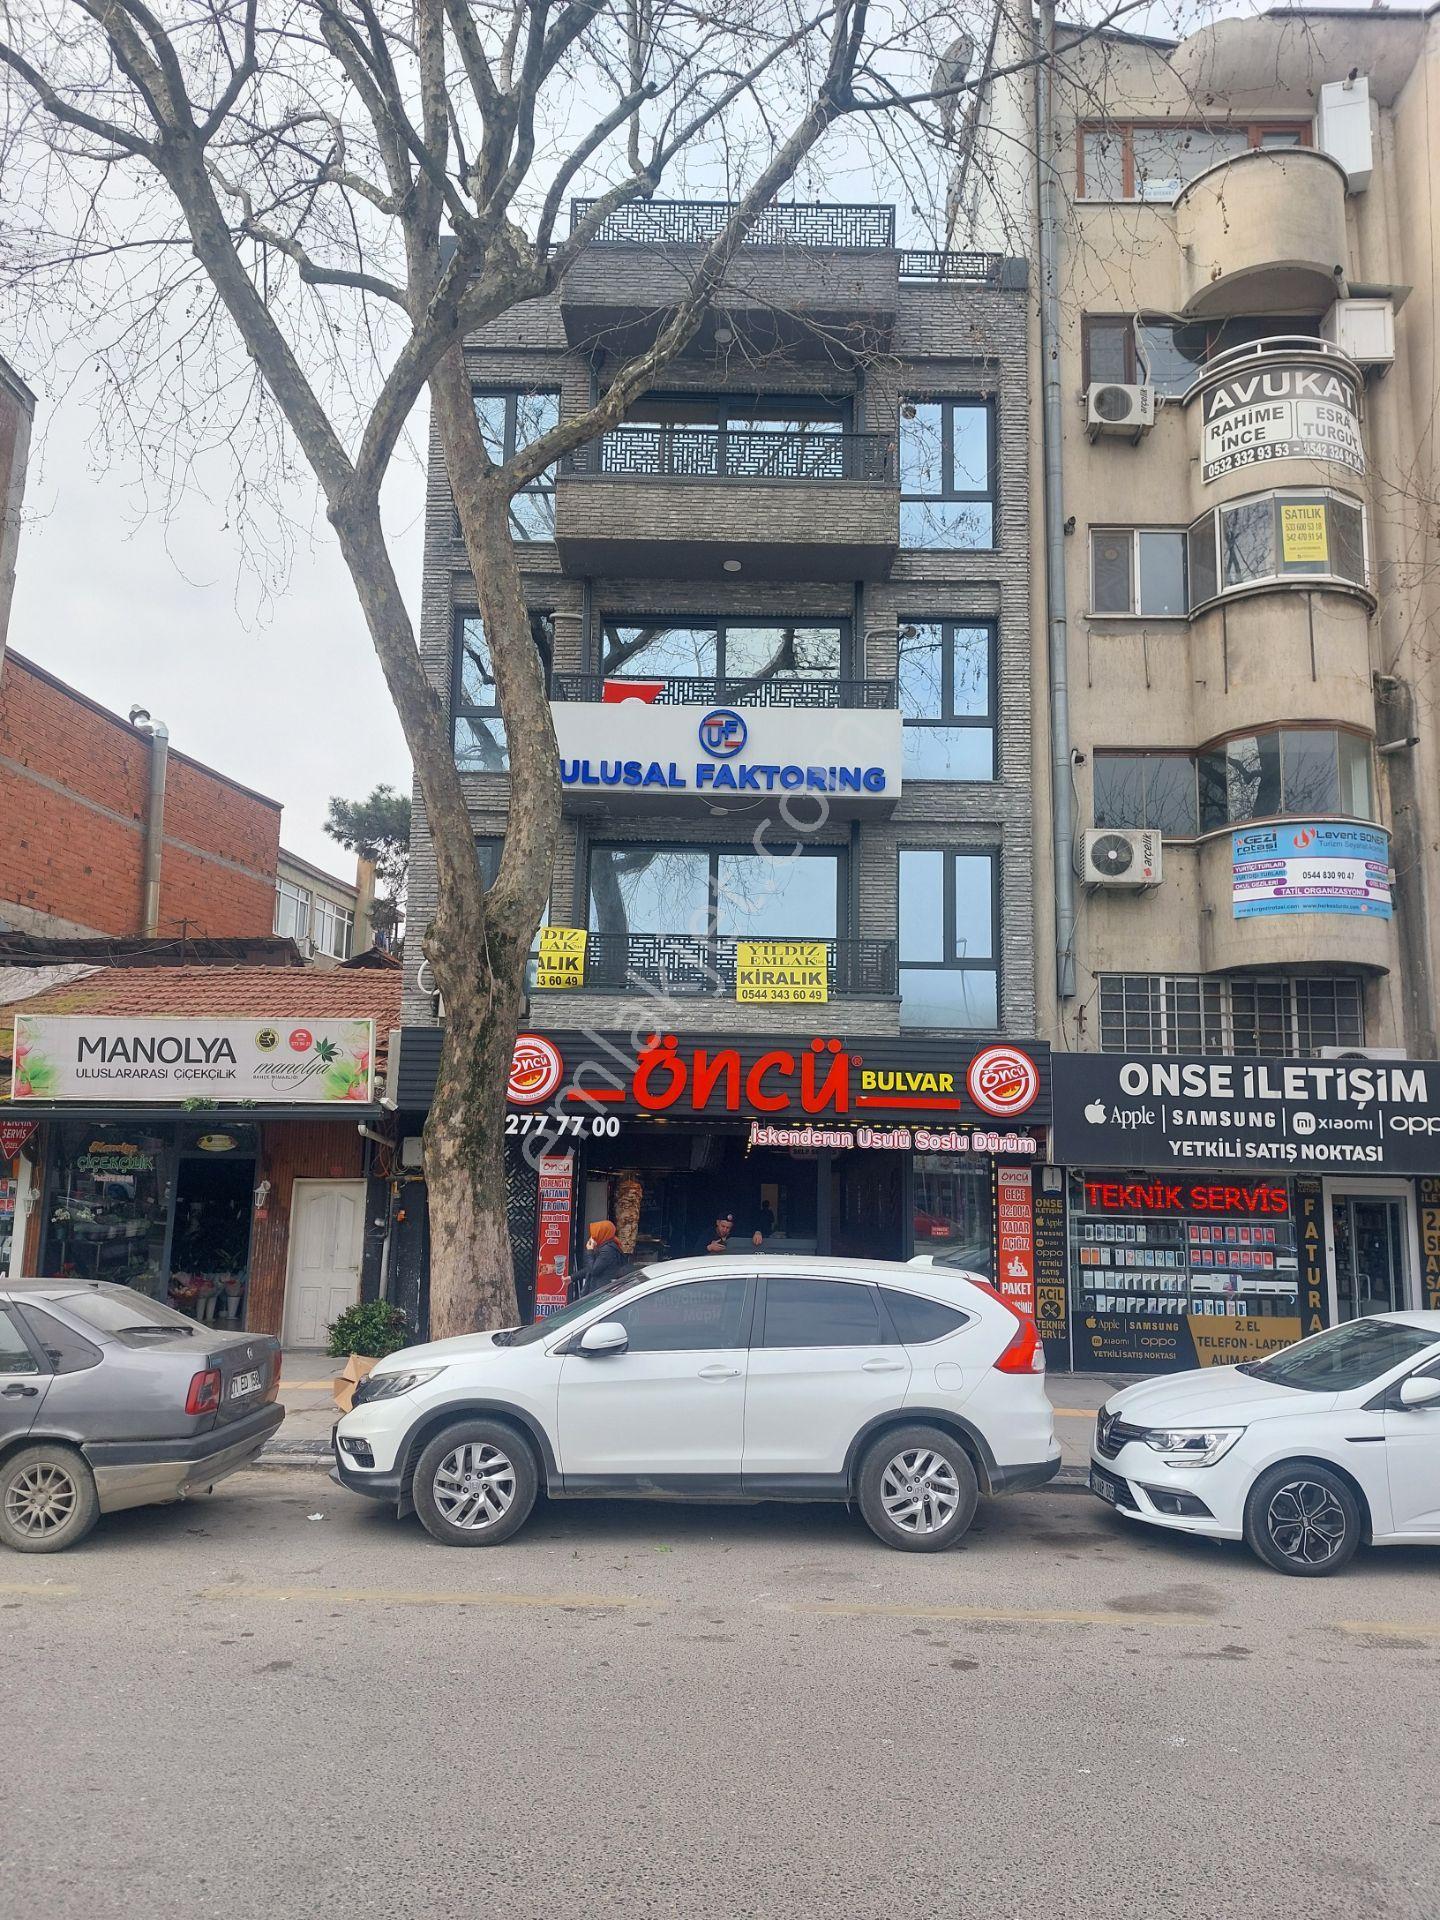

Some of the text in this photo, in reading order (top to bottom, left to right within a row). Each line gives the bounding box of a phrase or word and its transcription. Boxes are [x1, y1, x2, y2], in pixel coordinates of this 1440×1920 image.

[1208, 372, 1354, 418] AVUKAT
[1211, 407, 1284, 440] RAHİME
[1316, 407, 1351, 429] ESRA
[1221, 427, 1266, 452] İNCE
[1303, 423, 1359, 451] TURGUT
[1208, 459, 1232, 477] 0532
[1235, 451, 1254, 464] 332
[1257, 447, 1272, 459] 93
[1275, 443, 1289, 455] 53
[1285, 509, 1321, 519] SATILIK
[559, 759, 686, 788] ULUSAL
[1316, 829, 1357, 840] Levent
[1143, 832, 1154, 866] arçelik
[1303, 871, 1355, 880] 0544 830 90 47
[1281, 886, 1365, 897] TATİL ORGANİZASYONU
[749, 946, 820, 956] YILDIZ
[751, 957, 816, 966] EMLAK
[549, 976, 561, 986] 60
[565, 977, 577, 986] 49
[740, 969, 822, 986] KİRALIK
[742, 990, 822, 1000] 0544 343 60 49
[77, 1036, 237, 1064] MANOLYA
[76, 1068, 168, 1079] ULUSLARARASI
[862, 1071, 954, 1093] BULVAR
[1119, 1062, 1428, 1110] ONSE İLETİŞİM
[1110, 1105, 1156, 1130] Apple
[1172, 1109, 1276, 1128] SAMSUNG
[505, 1115, 620, 1137] 277 77 00
[2, 1127, 27, 1139] SERVİS
[751, 1122, 1036, 1153] İskenderun Usulü Soslu Dürüm
[1168, 1138, 1384, 1163] YETKİLİ SATIŞ NOKTASI
[1005, 1188, 1025, 1201] GECE
[1084, 1179, 1289, 1213] TEKNİK SERVİS
[1036, 1199, 1063, 1208] ONSE
[1002, 1221, 1030, 1234] KADAR
[1304, 1199, 1323, 1332] FATURA
[1002, 1282, 1031, 1294] PAKET
[1036, 1319, 1066, 1330] TEKNİK
[1099, 1319, 1179, 1331] Apple SAMSUNG
[1235, 1321, 1260, 1331] 2. EL
[1140, 1338, 1176, 1347] oppo
[1197, 1336, 1247, 1348] TELEFON
[1093, 1349, 1176, 1360] YETKİLİ SATIŞ NOKTASI
